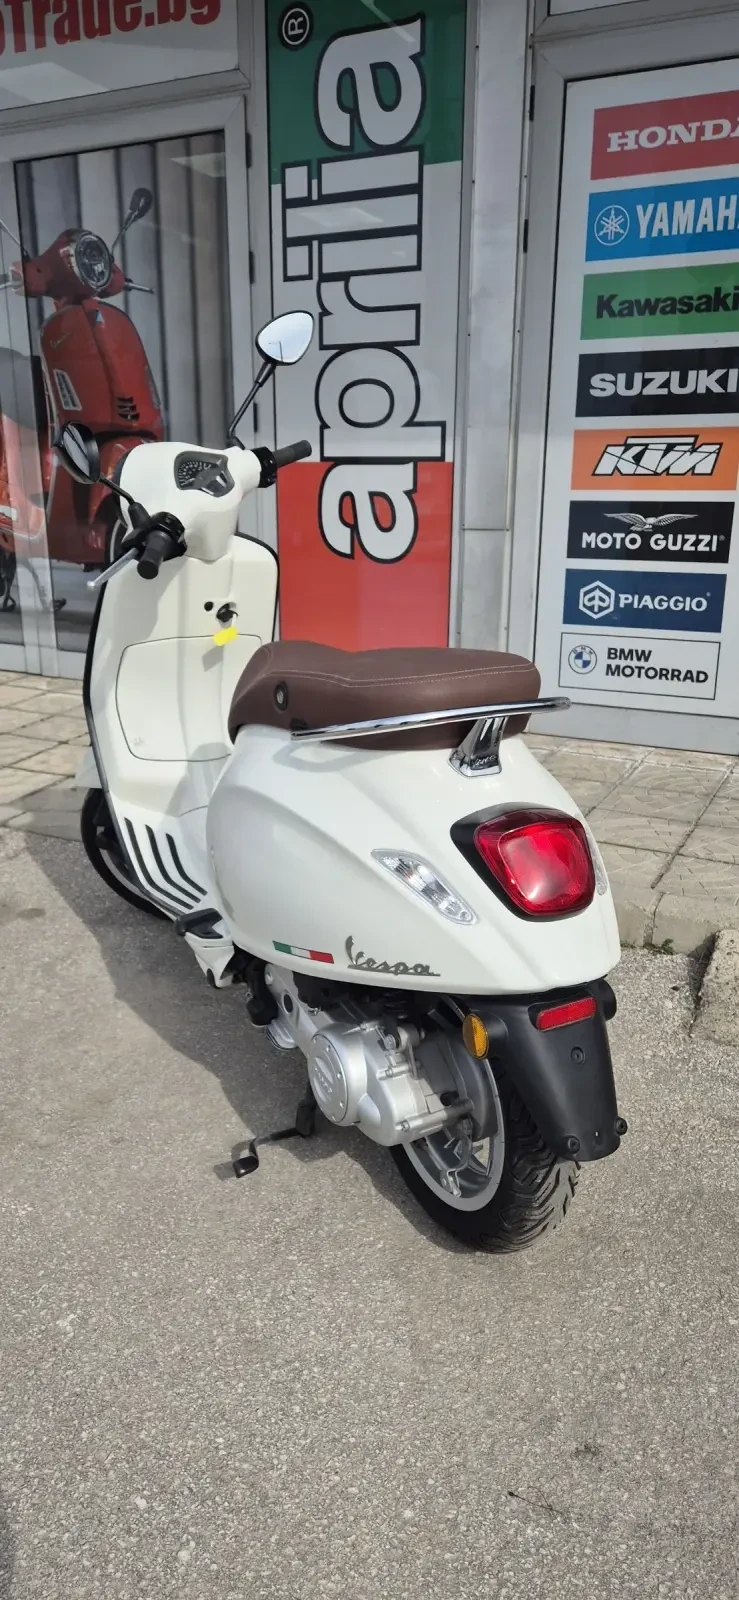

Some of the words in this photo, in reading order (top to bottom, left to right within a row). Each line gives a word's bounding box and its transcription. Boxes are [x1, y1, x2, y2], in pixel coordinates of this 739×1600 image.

[636, 194, 739, 238] YAMAH
[282, 17, 447, 564] aprilia
[596, 286, 739, 319] Kawasaki
[589, 367, 739, 398] SUZUKI
[592, 435, 723, 476] KTM
[581, 532, 642, 550] MOTO
[650, 534, 718, 552] GUZZI
[618, 593, 708, 612] PIAGGIO
[606, 647, 652, 662] BMW
[605, 663, 709, 683] MOTORRAD
[345, 935, 441, 976] Vespa
